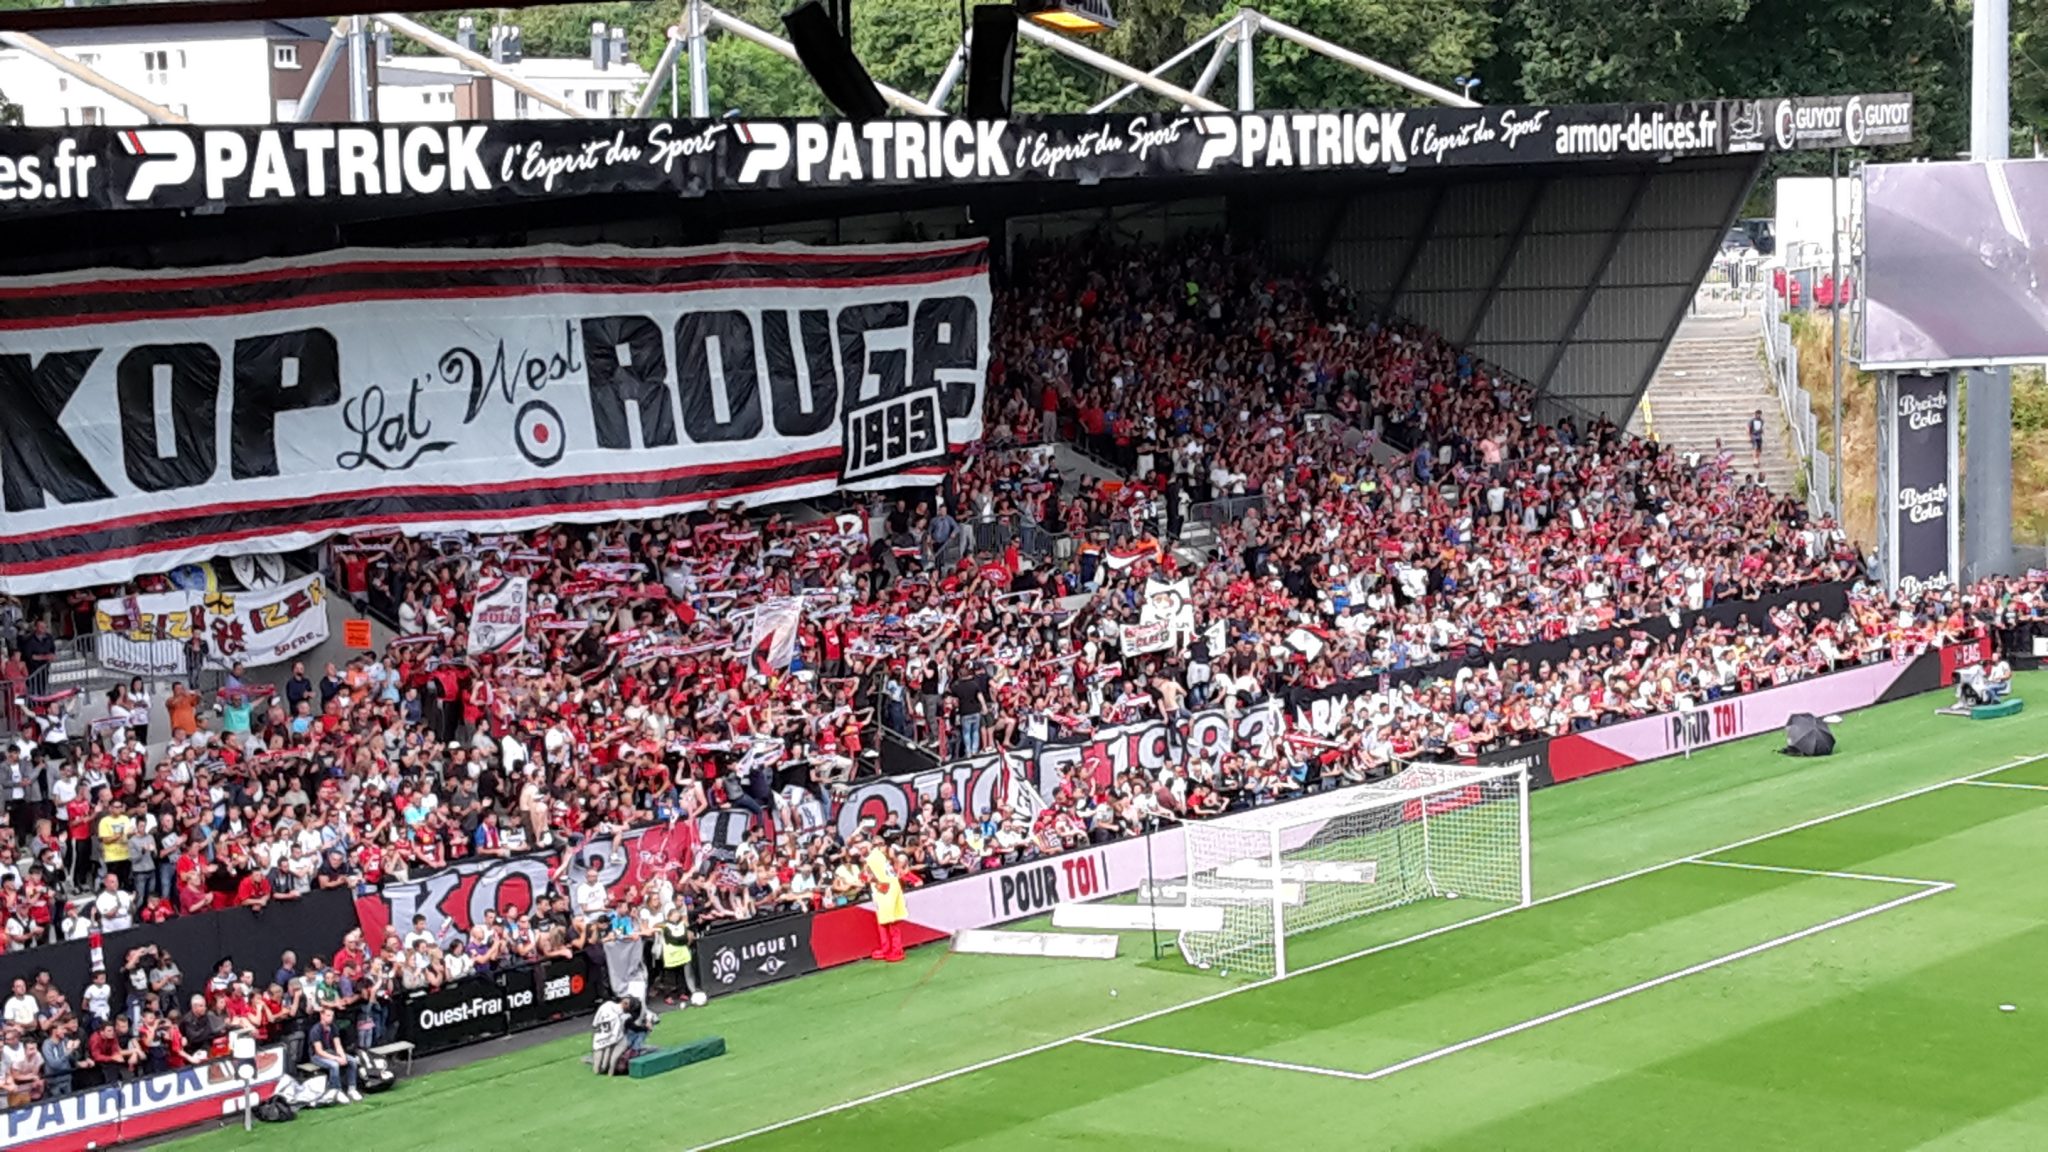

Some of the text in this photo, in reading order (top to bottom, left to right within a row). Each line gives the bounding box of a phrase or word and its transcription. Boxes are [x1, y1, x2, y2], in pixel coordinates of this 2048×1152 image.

[1241, 112, 1407, 168] PATRICK
[1410, 110, 1549, 163] l'Esprit du Sport
[1555, 110, 1717, 154] armor-delices.fr
[1796, 106, 1843, 129] GUYOT
[1865, 102, 1911, 126] GUYOT
[204, 126, 492, 200] PATRICK
[501, 123, 728, 192] l'Esprit du Sport
[797, 119, 1010, 183] PATRICK
[1015, 116, 1190, 177] l'Esprit du Sport
[438, 320, 582, 425] West
[0, 327, 341, 513] KOP
[1898, 390, 1948, 417] Breizh
[1909, 409, 1943, 430] Cola
[849, 395, 939, 472] 1993
[1898, 483, 1949, 510] Breizh
[1909, 503, 1944, 524] Cola
[1713, 703, 1736, 738] TOI
[1000, 865, 1060, 916] POUR
[1062, 854, 1099, 900] TOI
[741, 936, 786, 961] LIGUE
[8, 1067, 203, 1138] PATRICK
